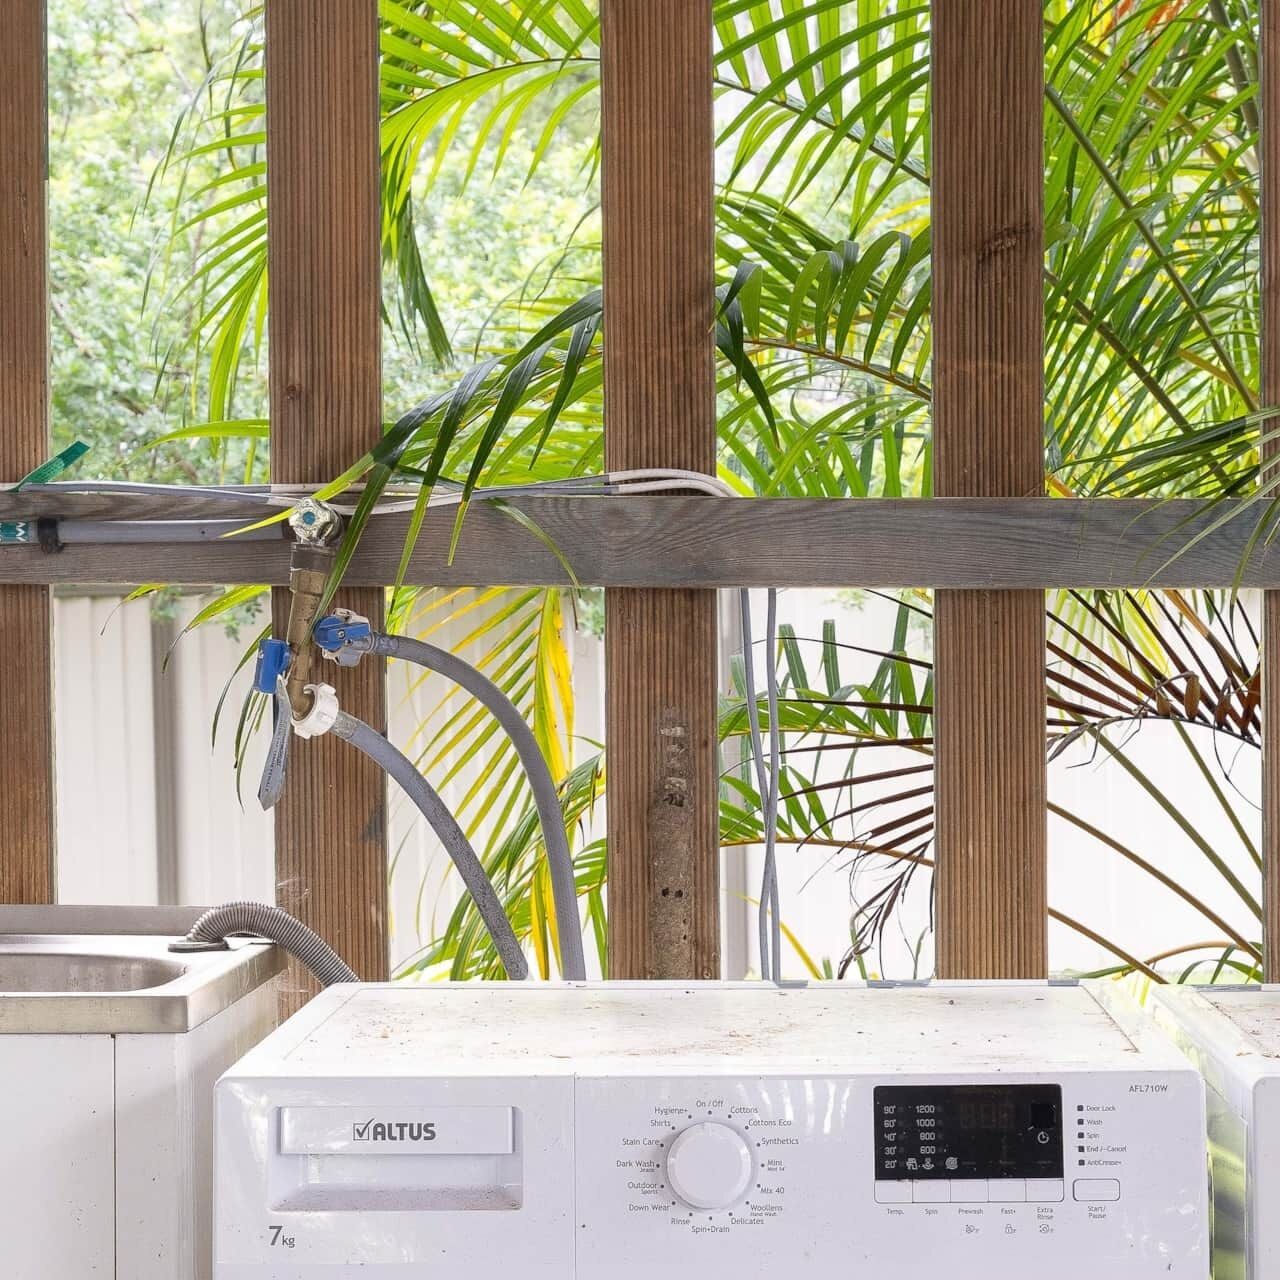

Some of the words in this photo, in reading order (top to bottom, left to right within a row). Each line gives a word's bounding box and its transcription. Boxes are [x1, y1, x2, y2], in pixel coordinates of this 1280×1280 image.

[654, 1106, 688, 1115] Hygiene+
[916, 1105, 935, 1113] 1200
[916, 1119, 936, 1127] 1000
[372, 1122, 436, 1141] ALTUS
[920, 1132, 936, 1140] 800
[622, 1138, 640, 1146] Stain
[643, 1138, 659, 1146] Care
[761, 1138, 799, 1146] Synthetics
[627, 1181, 657, 1189] Outdoor
[691, 1226, 730, 1234] Spin+Drain
